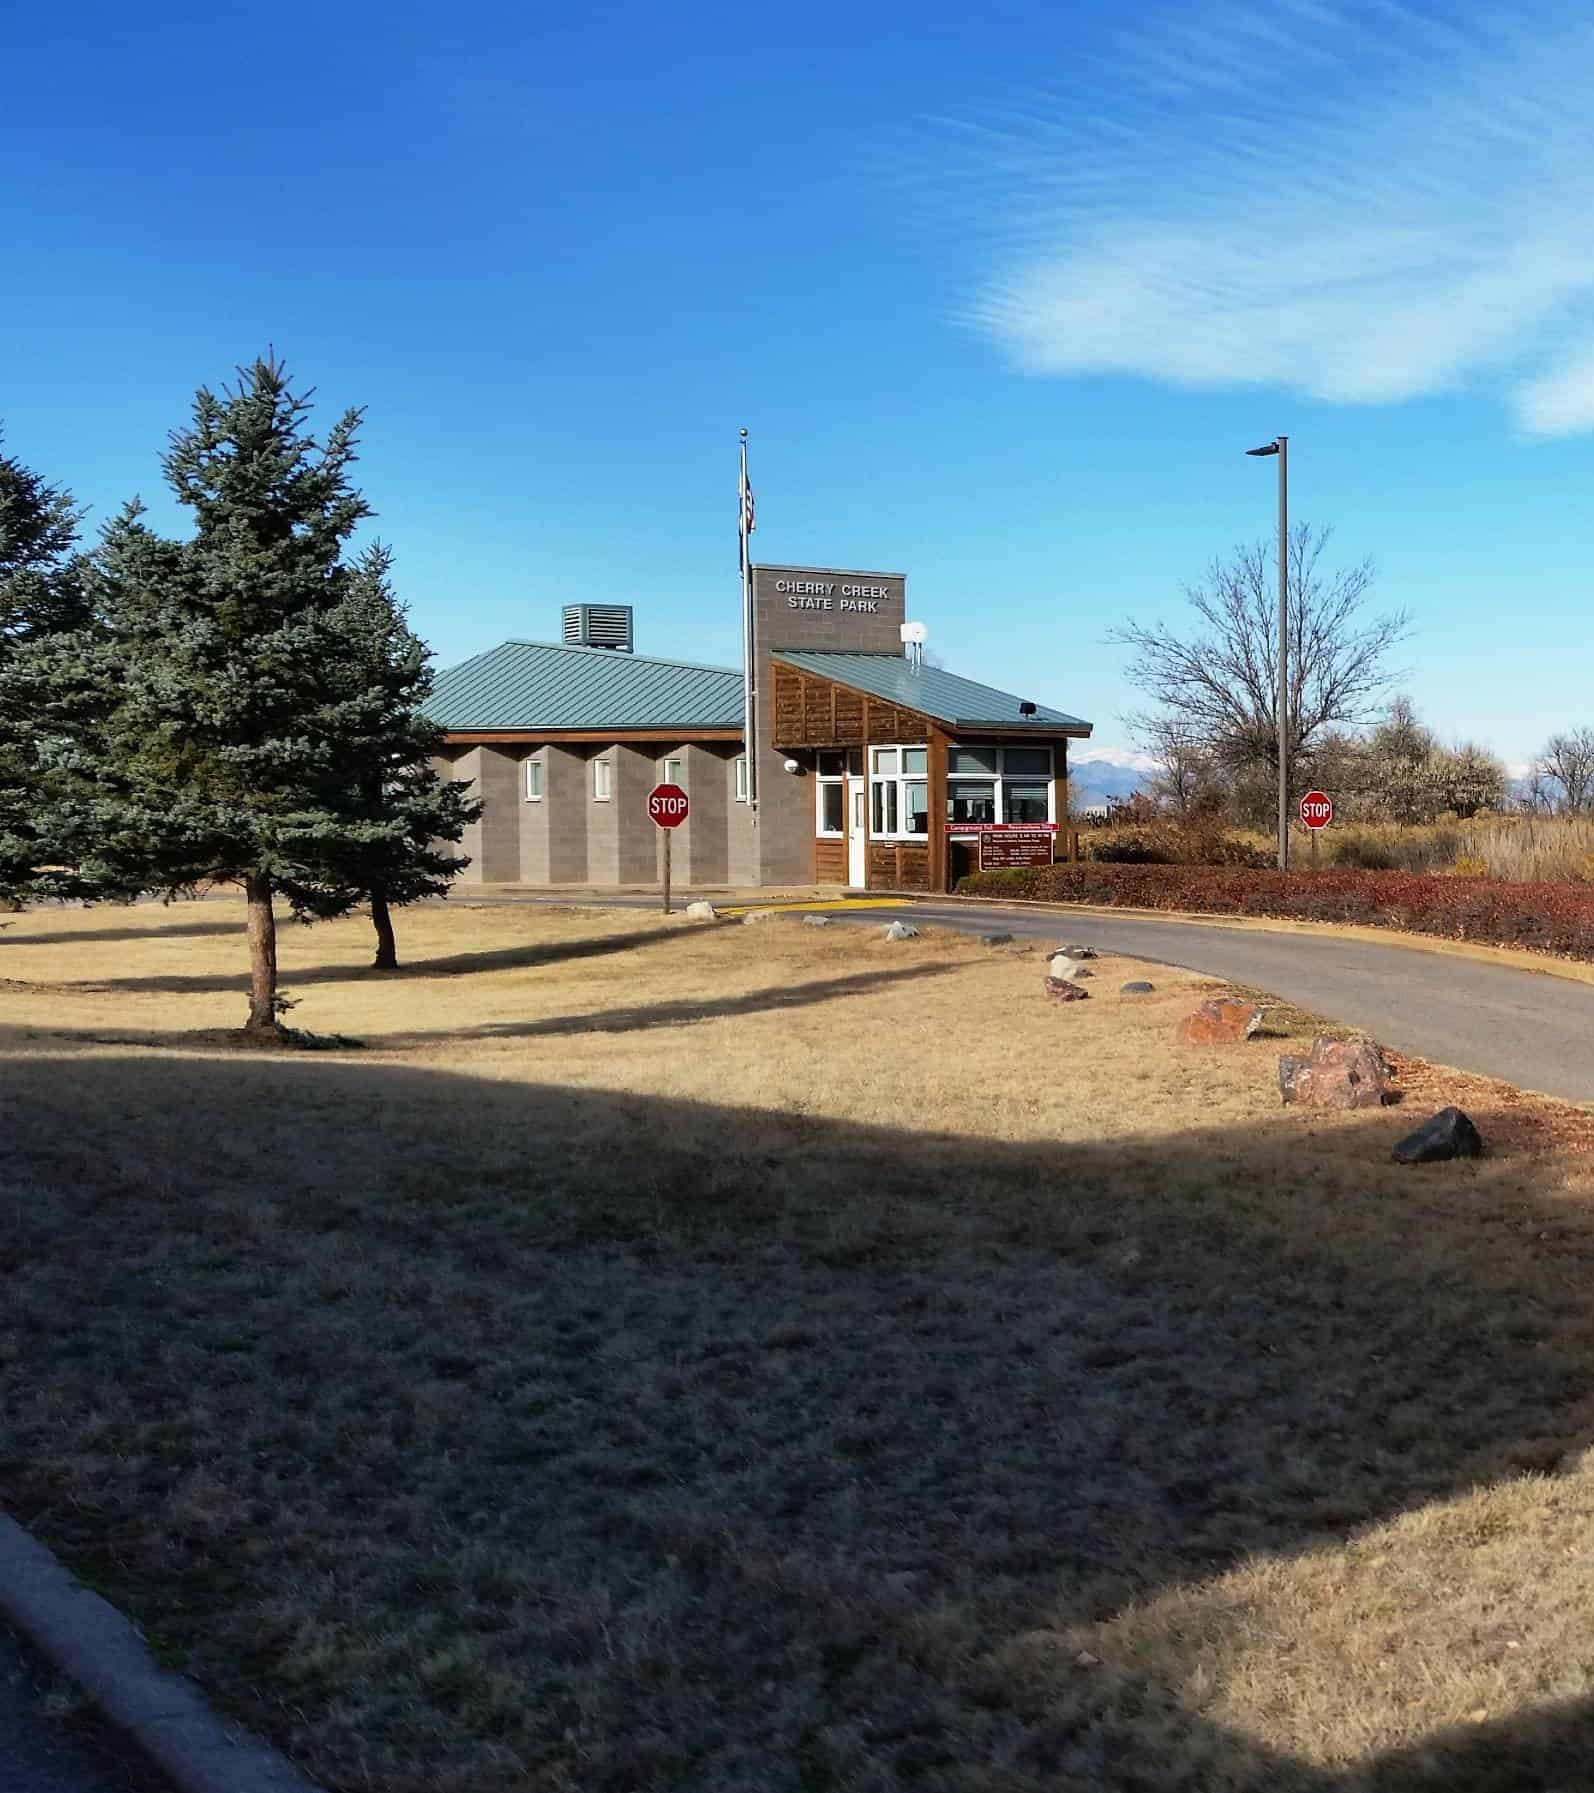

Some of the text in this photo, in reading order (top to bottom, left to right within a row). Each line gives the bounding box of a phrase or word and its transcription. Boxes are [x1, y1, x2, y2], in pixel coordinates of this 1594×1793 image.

[775, 579, 889, 599] CHERRY CREEK
[787, 596, 878, 613] STATE PARK
[651, 797, 687, 814] STOP
[1303, 803, 1329, 817] STOP
